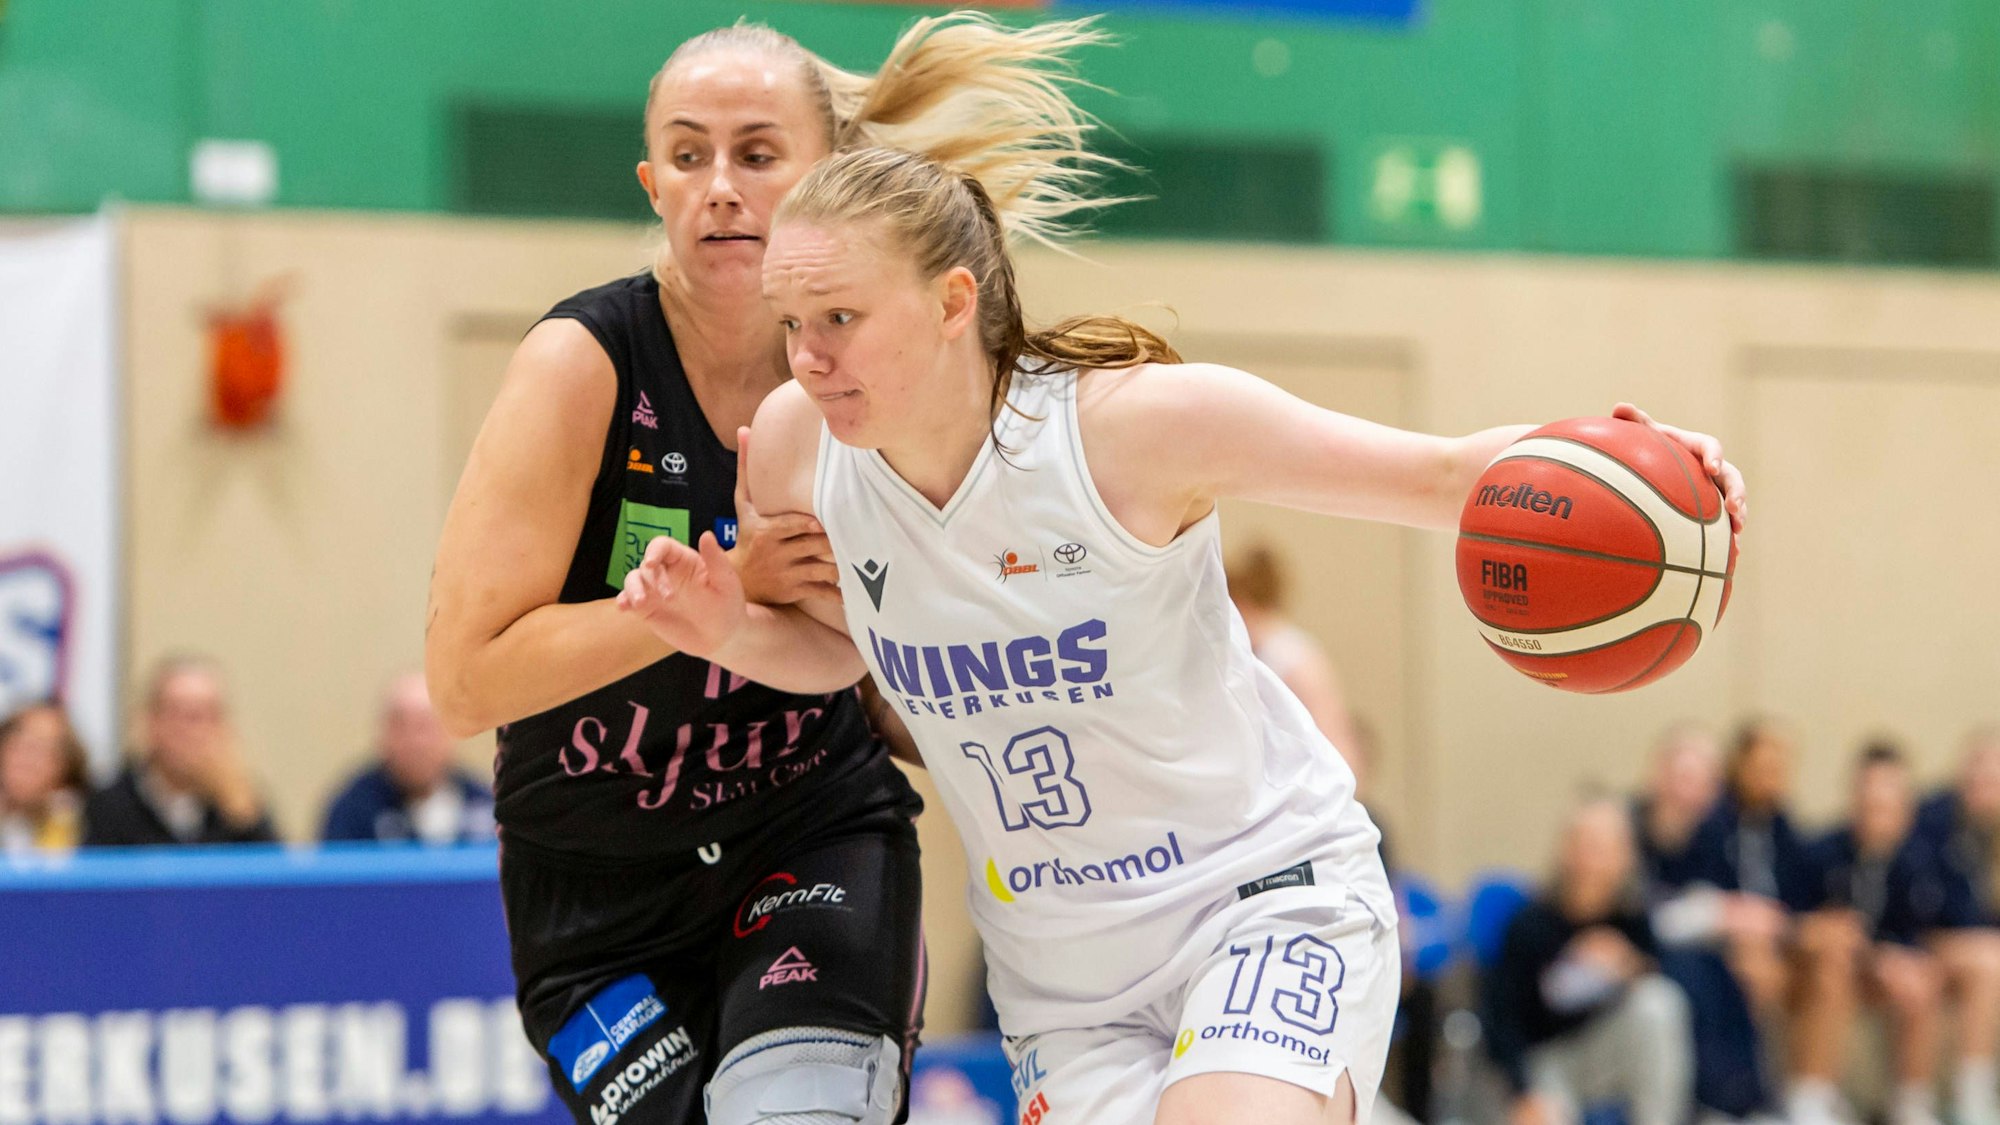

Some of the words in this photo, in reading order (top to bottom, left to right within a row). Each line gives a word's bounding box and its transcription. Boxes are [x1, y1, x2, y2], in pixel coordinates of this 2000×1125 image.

[1475, 483, 1573, 520] molten
[1481, 559, 1528, 592] FIBA
[1483, 590, 1529, 606] APPROVED
[868, 618, 1108, 699] WINGS
[897, 682, 1114, 720] EVERKUSEN
[960, 725, 1092, 832] 13
[1009, 831, 1184, 893] orthomol
[1265, 873, 1299, 885] macron
[747, 883, 847, 923] KernFit
[759, 967, 818, 990] PEAK
[1222, 932, 1346, 1036] 13
[609, 994, 656, 1037] CENTRAL
[615, 998, 666, 1046] GARAGE
[1200, 1021, 1331, 1065] orthomol
